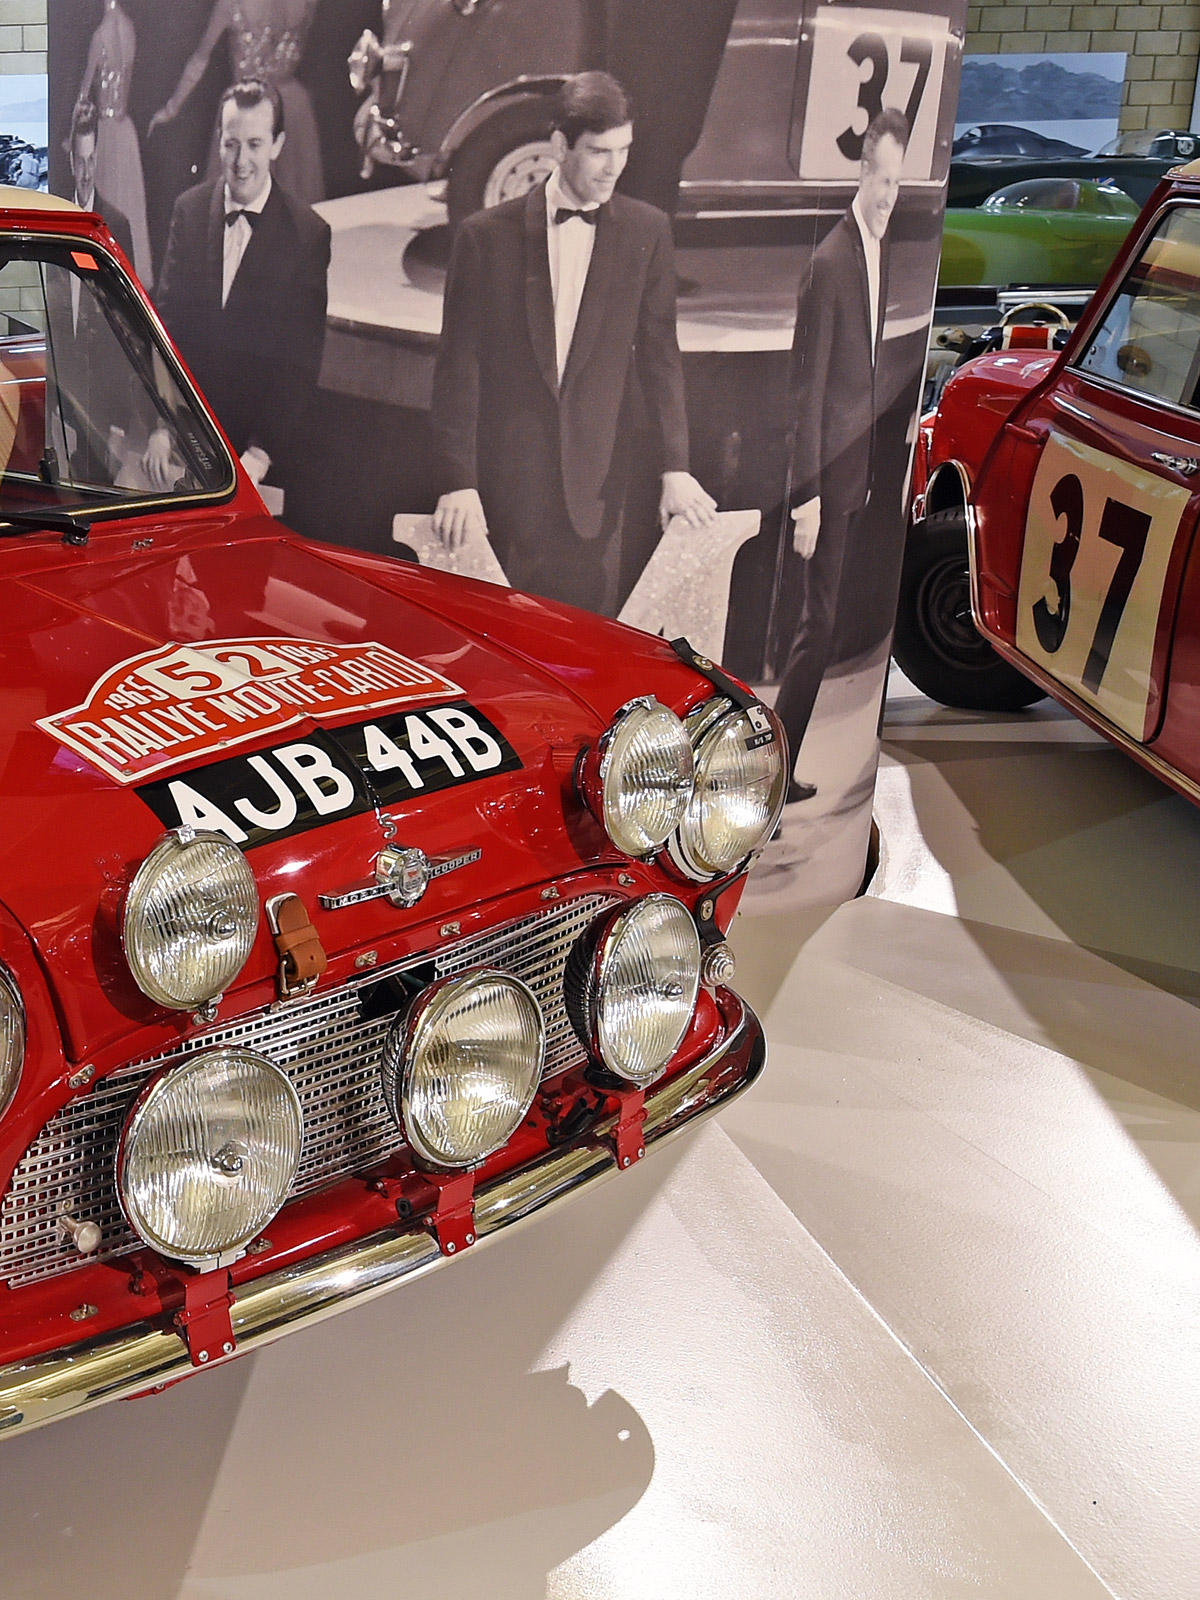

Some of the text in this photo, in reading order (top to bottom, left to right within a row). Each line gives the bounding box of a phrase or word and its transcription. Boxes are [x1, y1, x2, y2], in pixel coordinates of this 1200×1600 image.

[836, 32, 933, 162] 37
[1032, 474, 1152, 696] 37
[64, 650, 435, 766] RALLYE MONTE-CARLO
[103, 643, 340, 711] 1965 52 1965
[167, 707, 502, 842] AJB 44B
[379, 813, 398, 839] S
[434, 851, 480, 876] COOPER
